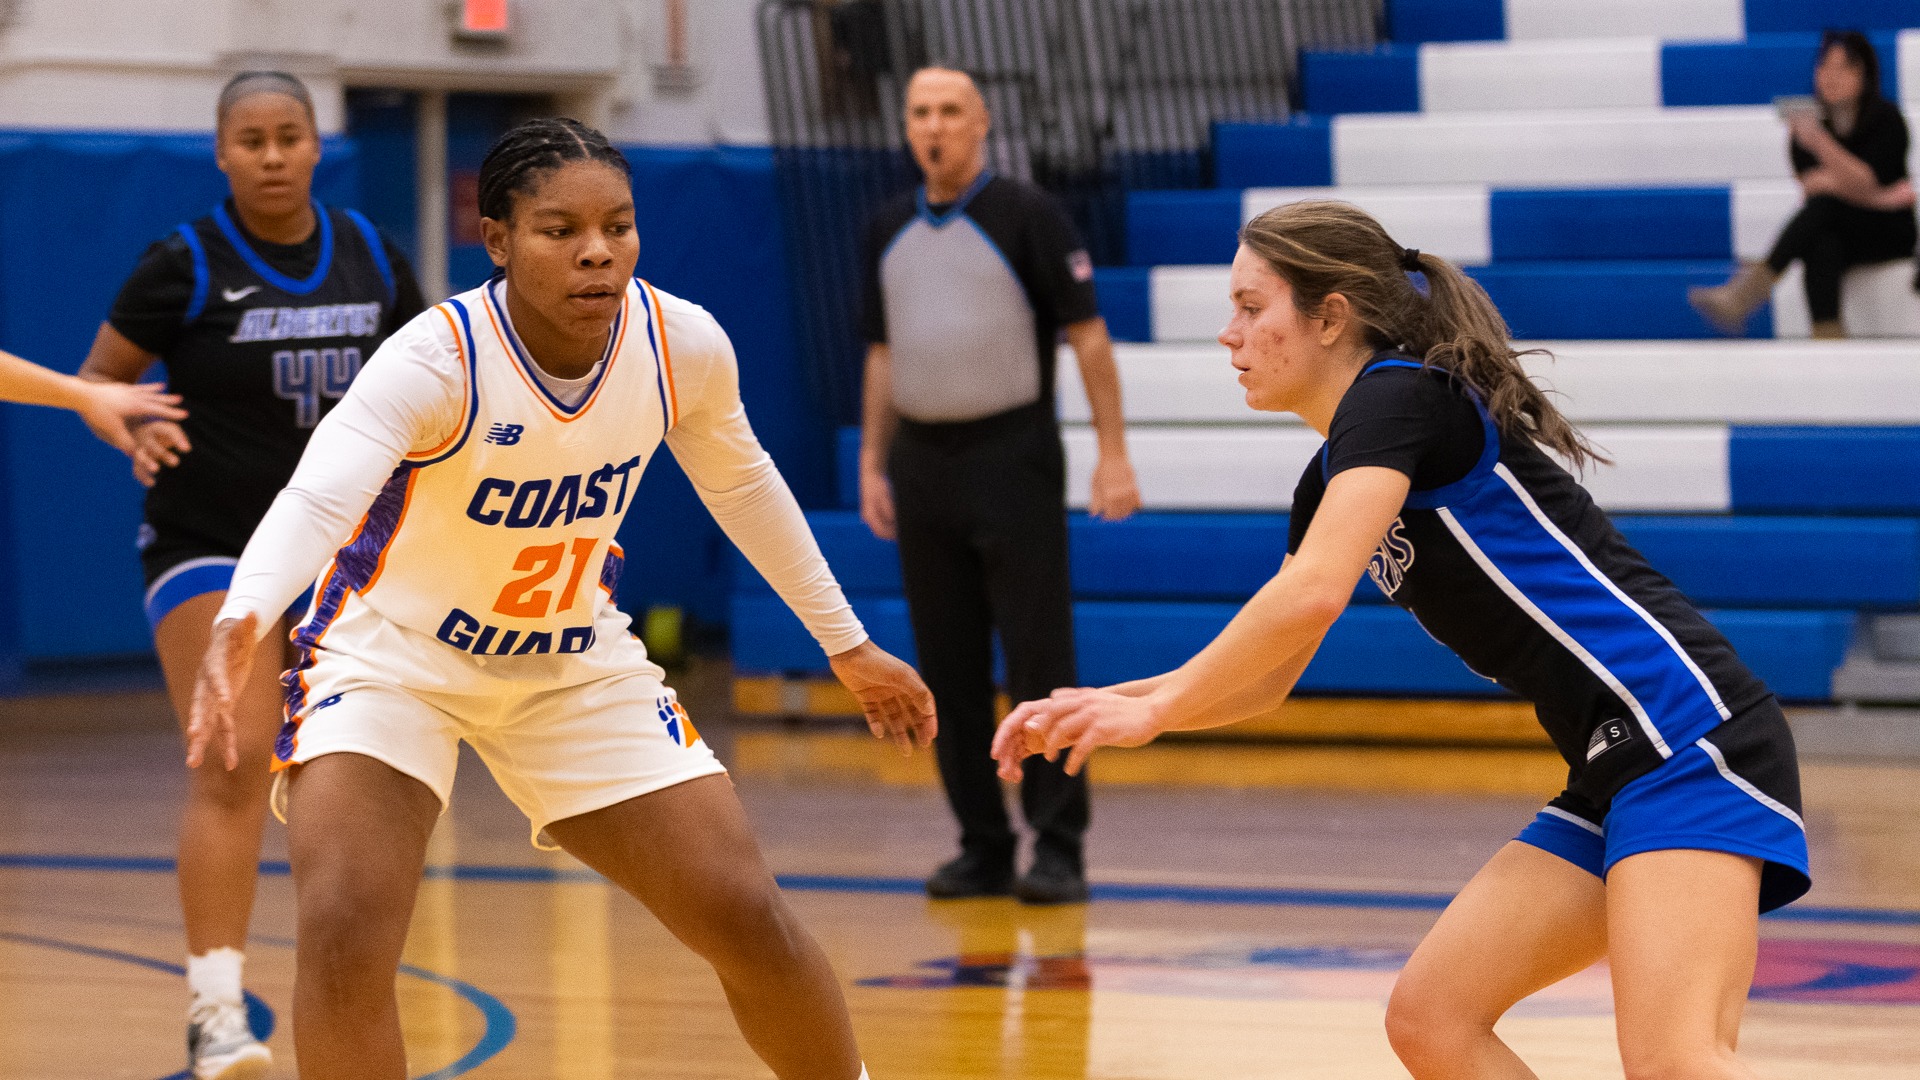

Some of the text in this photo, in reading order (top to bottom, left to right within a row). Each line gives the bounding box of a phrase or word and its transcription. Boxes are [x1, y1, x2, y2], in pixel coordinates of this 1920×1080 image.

[466, 455, 641, 528] COAST
[492, 537, 600, 618] 21
[1610, 726, 1621, 738] S
